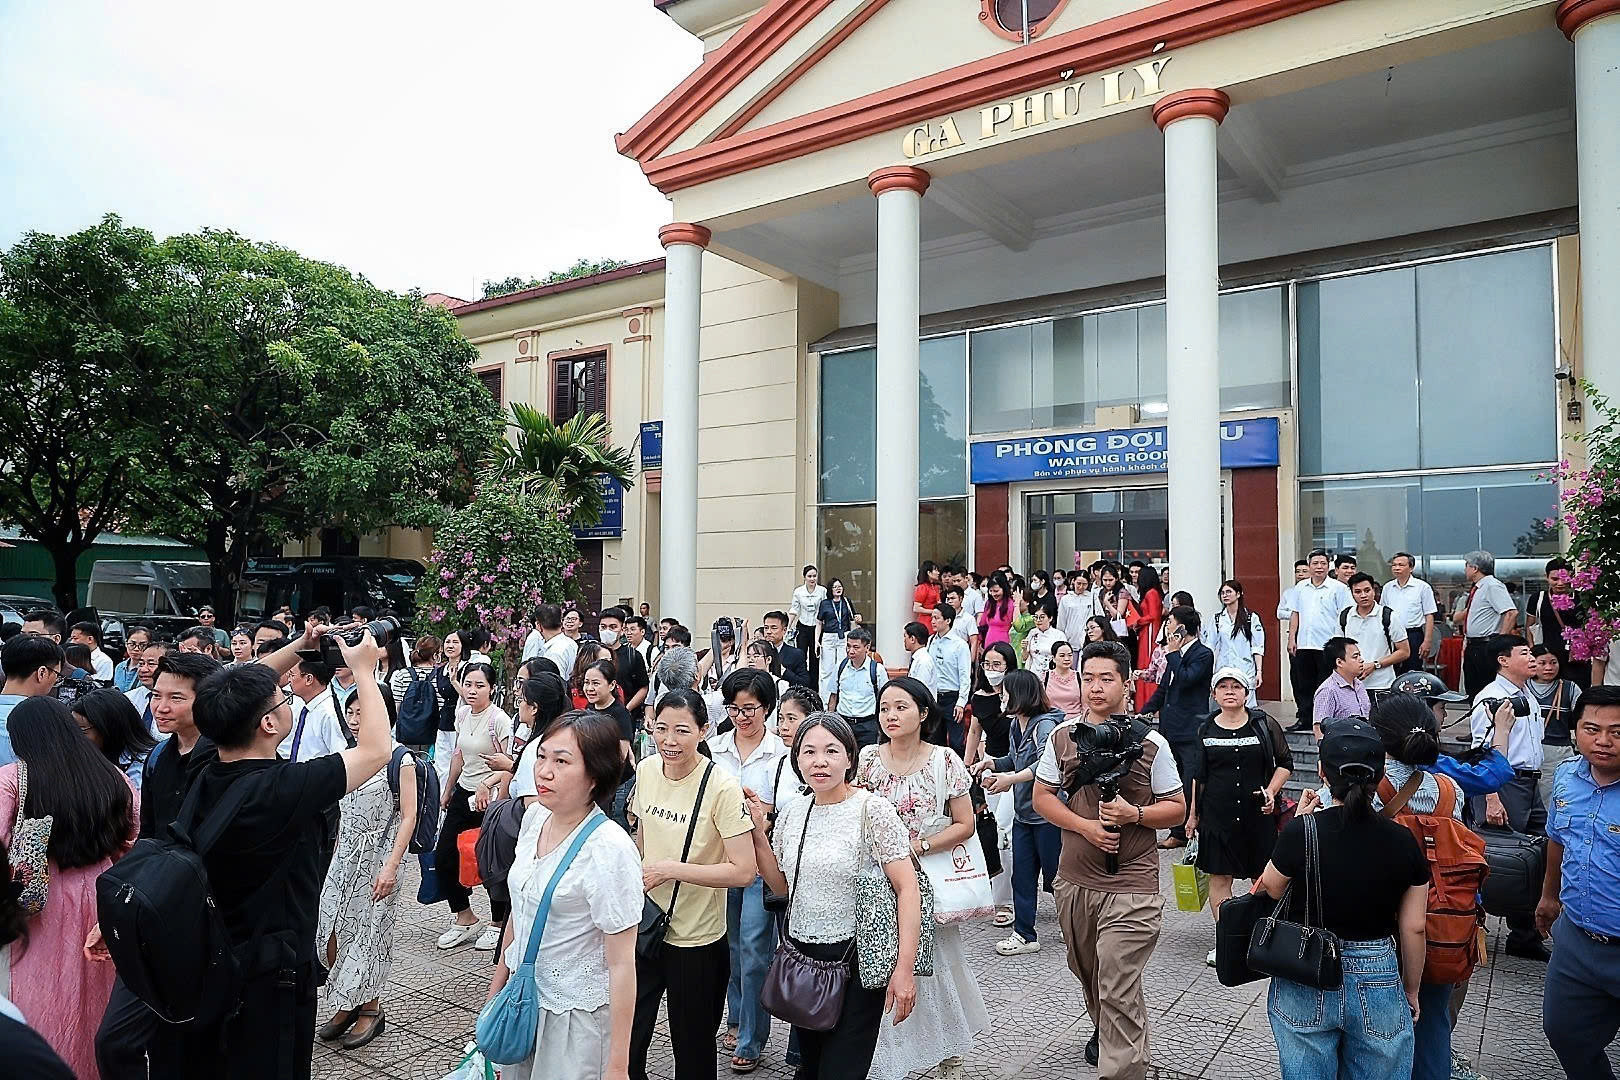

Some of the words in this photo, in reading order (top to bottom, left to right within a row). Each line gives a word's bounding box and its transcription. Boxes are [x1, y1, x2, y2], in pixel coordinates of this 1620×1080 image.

[902, 116, 965, 158] GA
[978, 68, 1085, 141] PHỦ
[1100, 42, 1172, 107] LÝ
[996, 437, 1097, 458] PHÒNG
[1106, 431, 1162, 452] ĐỢI
[1048, 454, 1120, 468] WAITING
